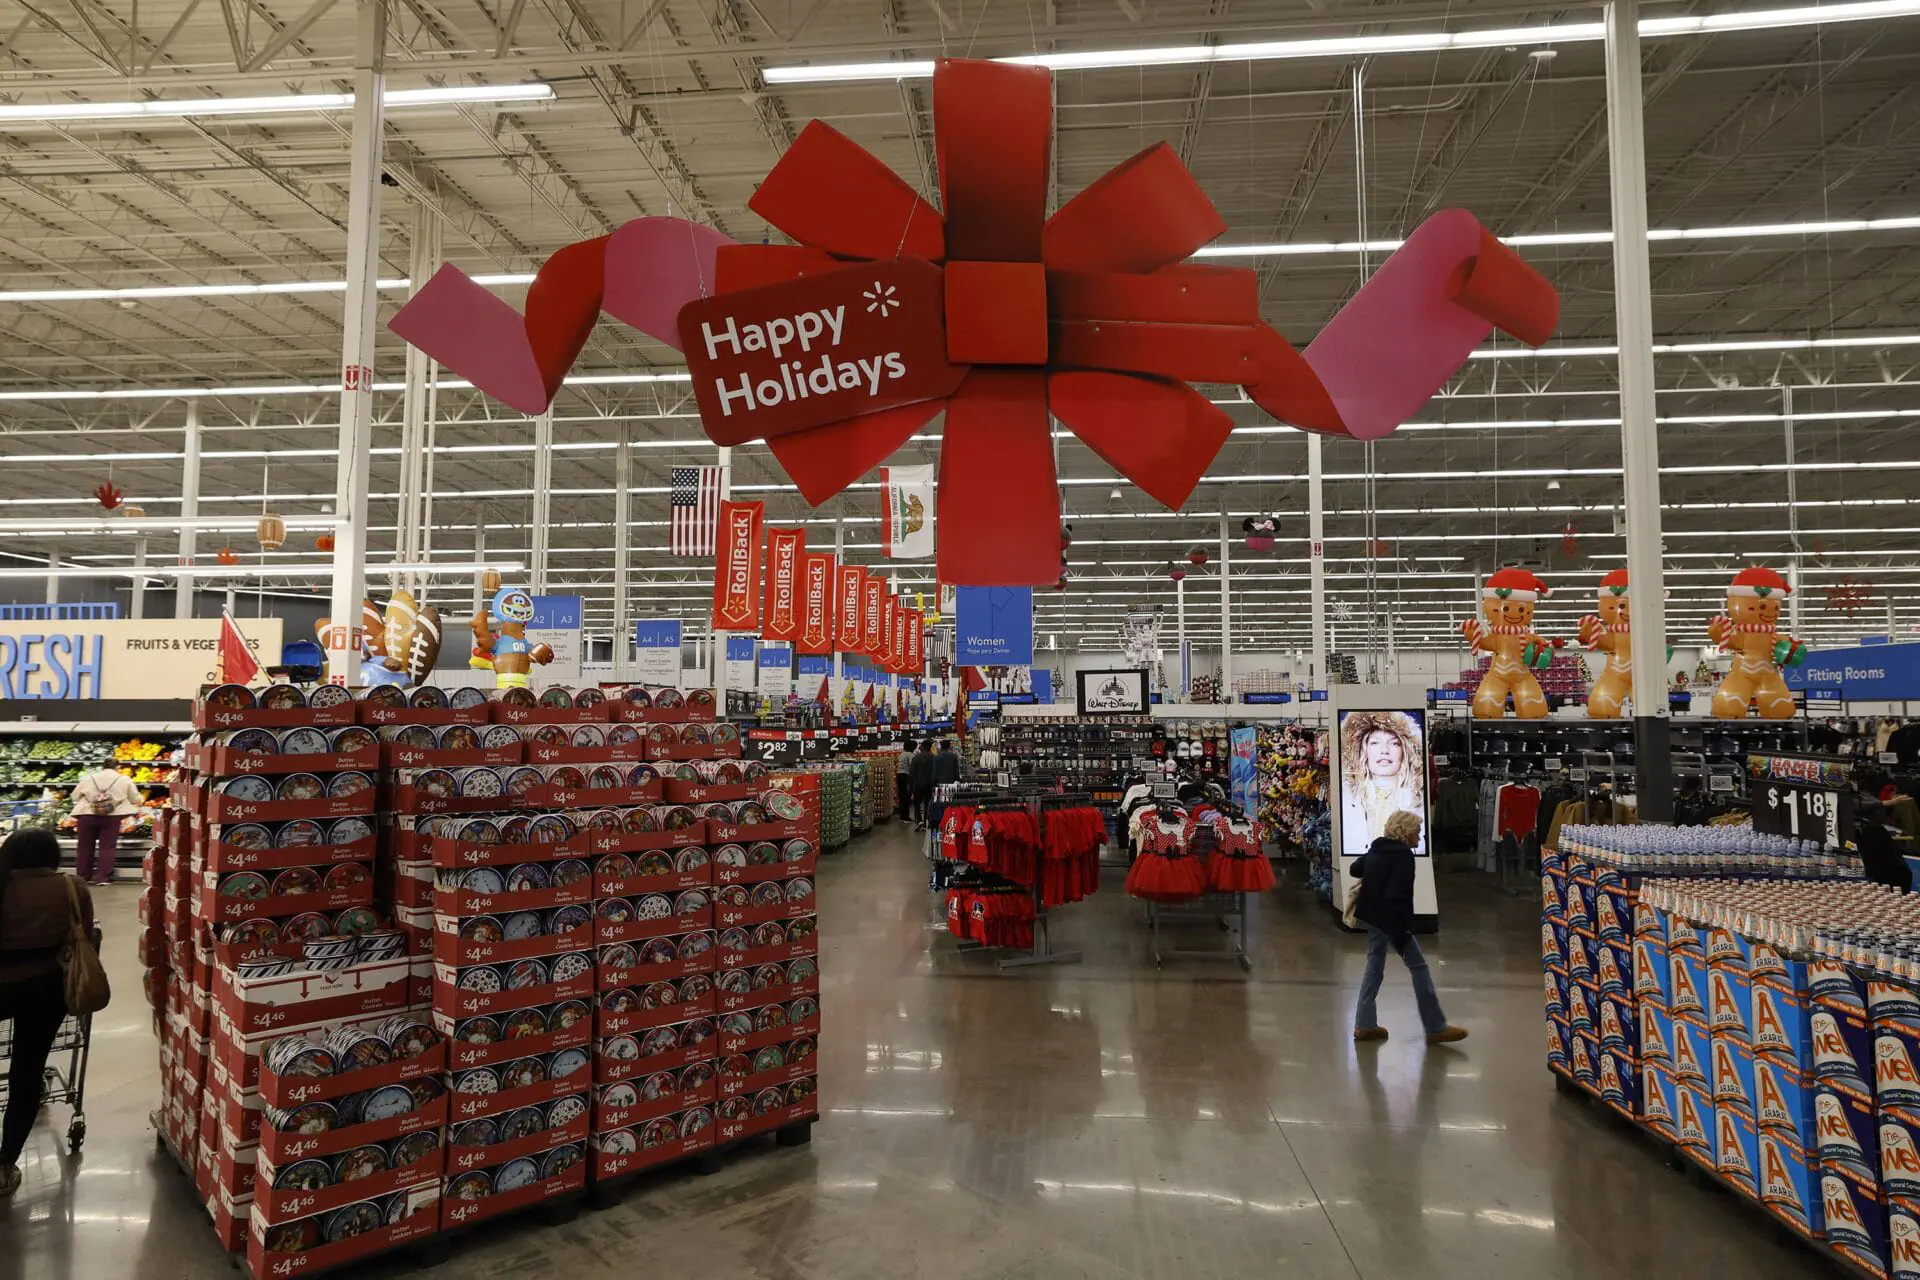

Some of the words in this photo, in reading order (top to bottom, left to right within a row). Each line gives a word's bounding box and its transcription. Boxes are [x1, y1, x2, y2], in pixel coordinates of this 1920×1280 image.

[701, 305, 846, 360] Happy
[715, 352, 906, 417] Holidays
[731, 517, 749, 594] RollBack
[777, 542, 793, 609] RollBack
[810, 566, 823, 626] RollBack
[845, 576, 857, 628] RollBack
[868, 587, 877, 634] RollBack
[533, 615, 545, 624] A2
[560, 615, 573, 624] A3
[126, 639, 169, 650] FRUITS
[172, 639, 180, 650] &
[967, 636, 1005, 646] Women
[1807, 668, 1842, 683] Fitting
[1845, 665, 1885, 680] Rooms
[1087, 697, 1112, 710] Walt
[1111, 696, 1139, 711] Disney
[1772, 757, 1818, 770] GAME
[1814, 1018, 1826, 1029] the
[1879, 1042, 1893, 1053] the
[400, 1068, 422, 1078] Cookies
[401, 1064, 419, 1072] Butter
[1818, 1100, 1831, 1111] the
[401, 1116, 419, 1125] Butter
[399, 1122, 421, 1131] Cookies
[1883, 1130, 1899, 1142] the
[398, 1169, 416, 1178] Butter
[396, 1175, 418, 1185] Cookies
[1825, 1181, 1837, 1192] the
[392, 1224, 410, 1234] Butter
[1893, 1220, 1908, 1231] the
[389, 1230, 412, 1241] Cookies
